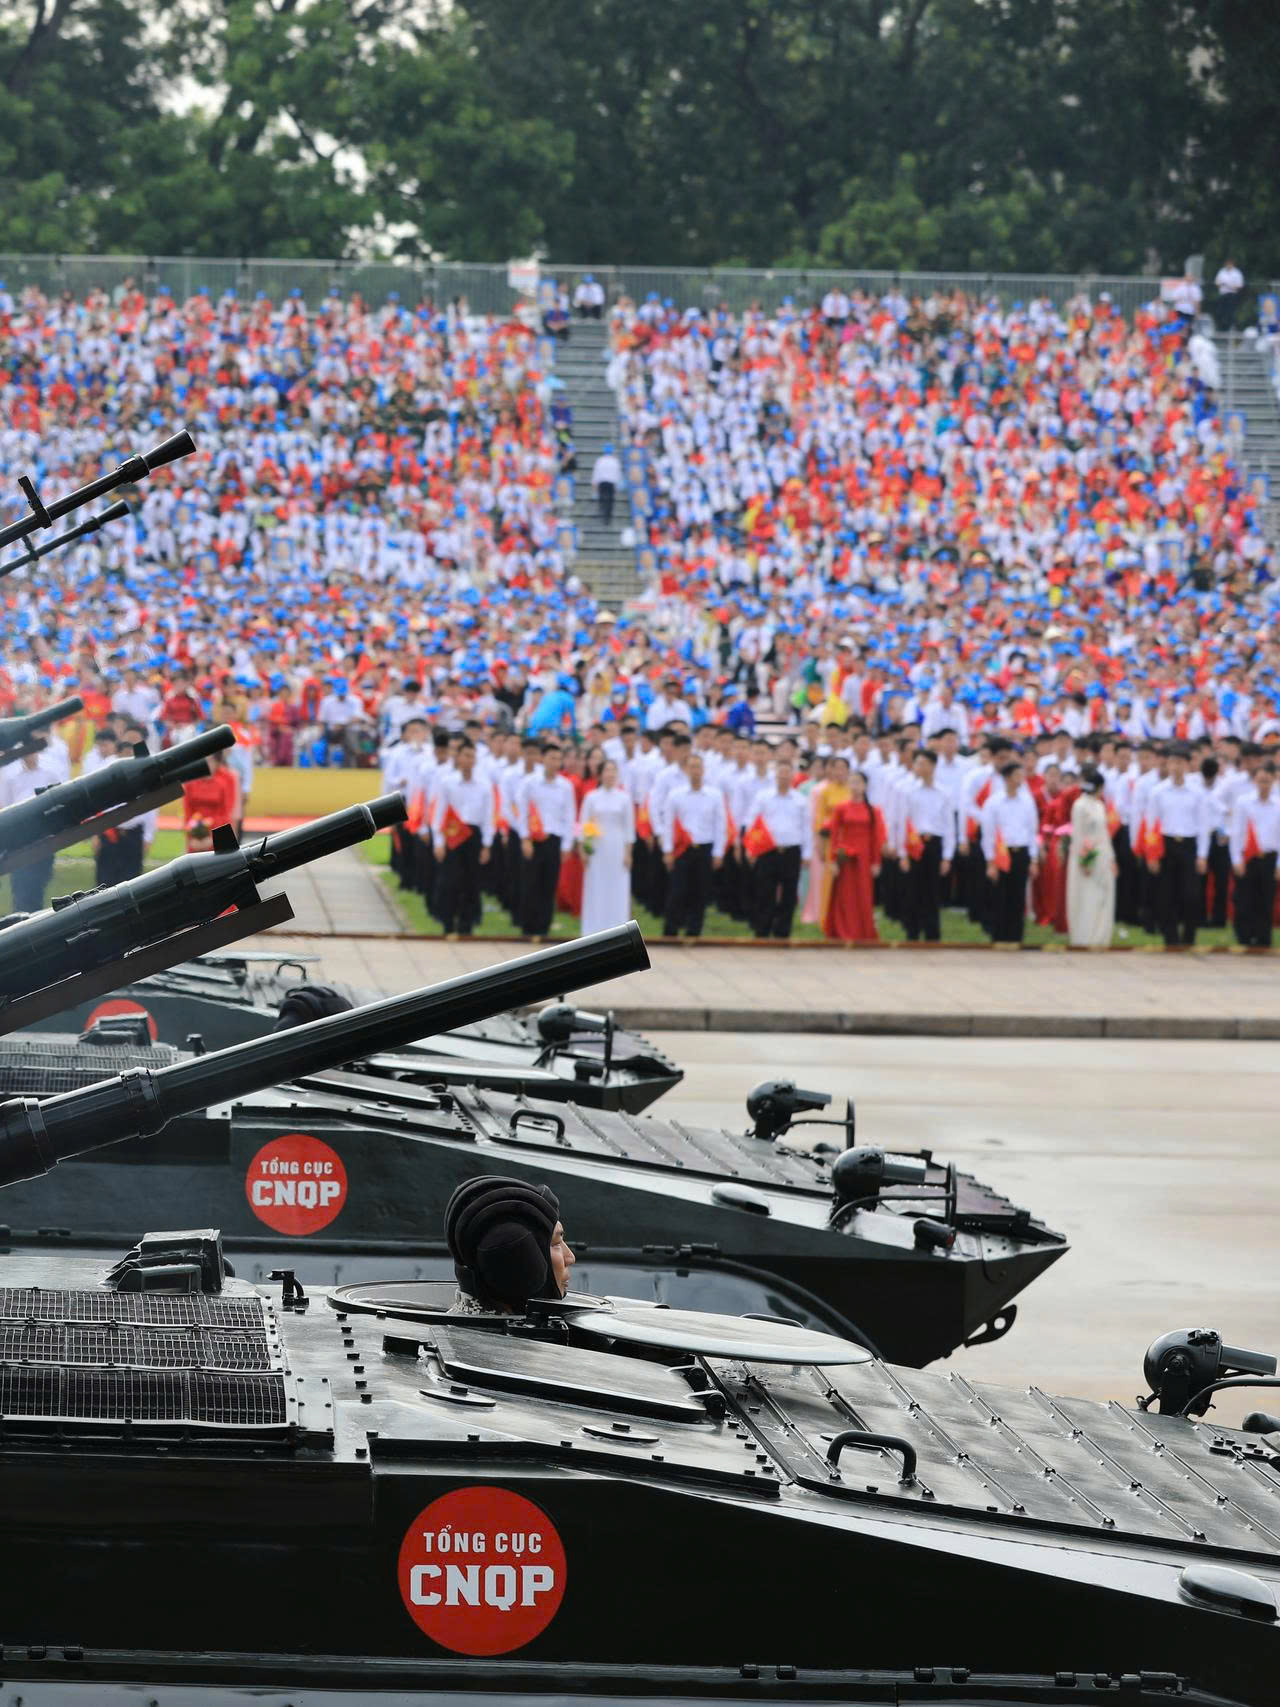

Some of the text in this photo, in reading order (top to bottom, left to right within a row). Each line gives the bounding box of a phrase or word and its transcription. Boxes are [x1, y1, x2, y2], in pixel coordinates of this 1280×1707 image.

[261, 1156, 333, 1178] TỔNG CỤC
[252, 1180, 340, 1209] CNQP
[423, 1524, 542, 1558] TỔNG CỤC
[410, 1564, 555, 1611] CNQP
